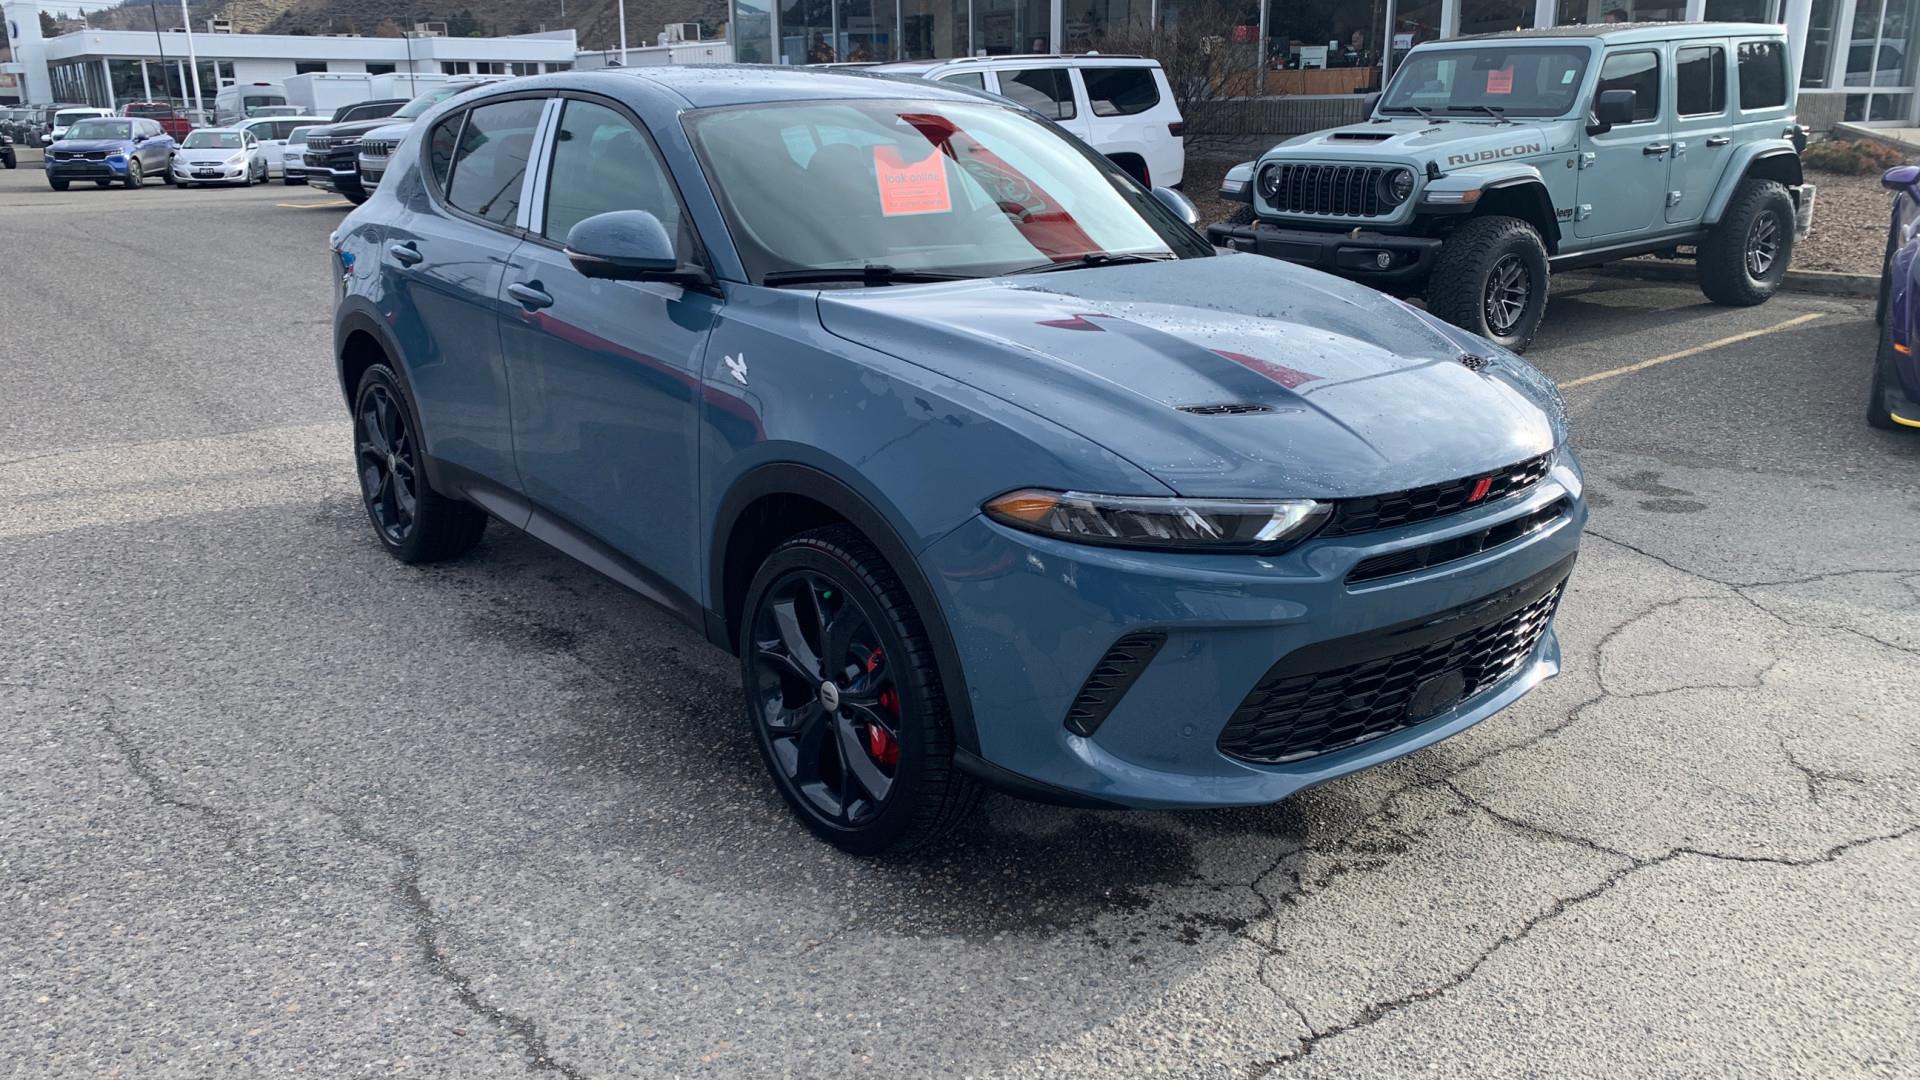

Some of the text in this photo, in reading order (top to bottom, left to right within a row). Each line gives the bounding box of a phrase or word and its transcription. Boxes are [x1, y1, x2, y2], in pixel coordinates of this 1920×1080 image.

[1448, 143, 1541, 165] RUBICON
[886, 172, 940, 185] look online
[1556, 208, 1573, 218] Jeep
